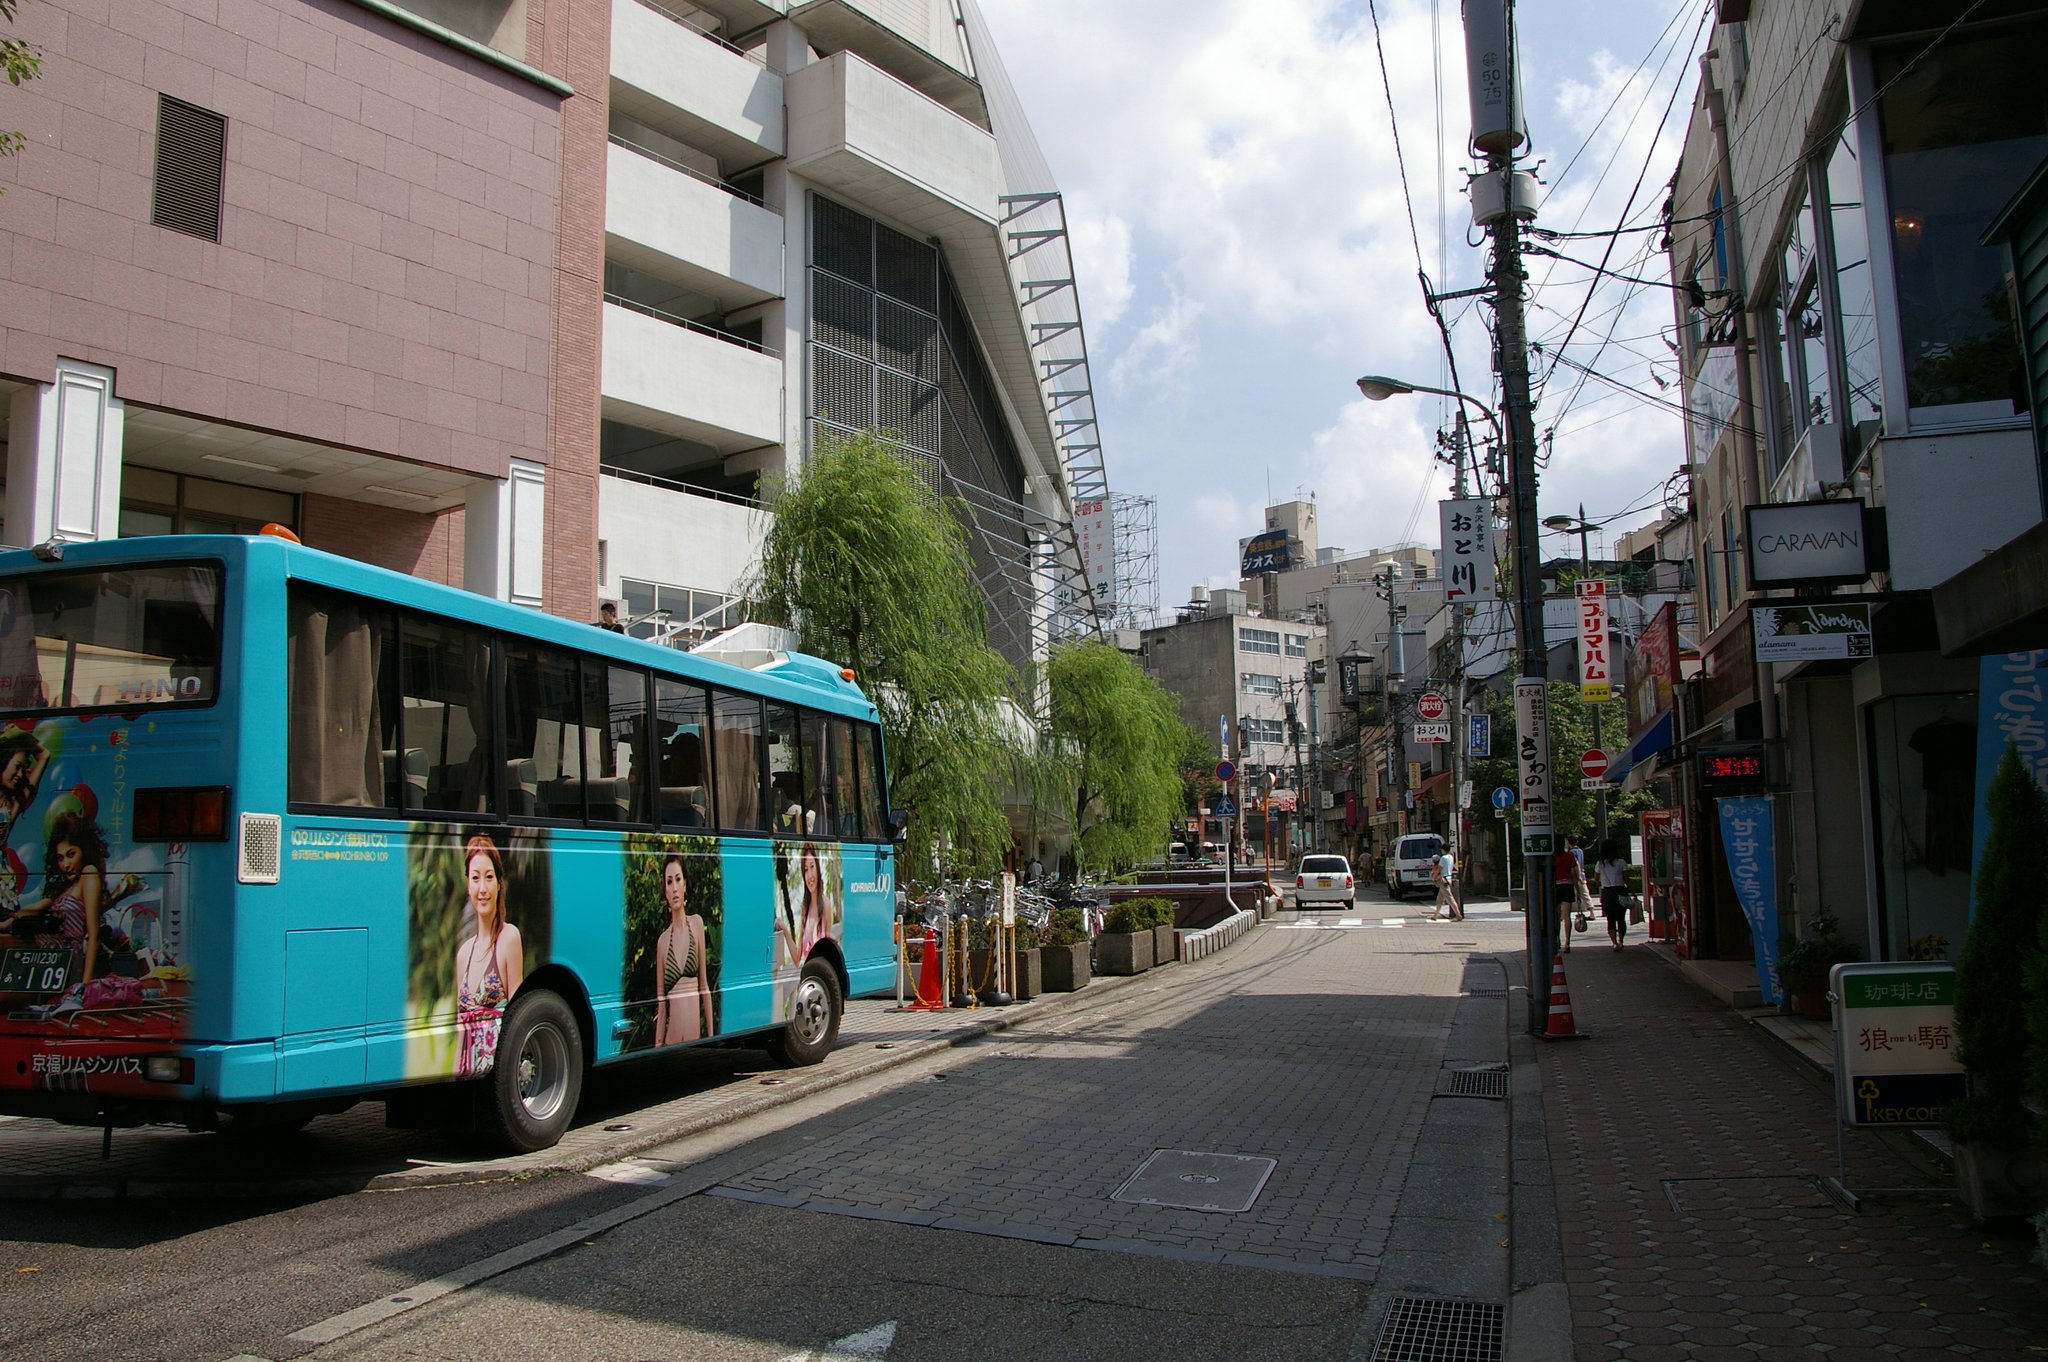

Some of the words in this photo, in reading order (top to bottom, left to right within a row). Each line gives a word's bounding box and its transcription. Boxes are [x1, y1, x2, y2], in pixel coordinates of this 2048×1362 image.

[1482, 69, 1501, 82] 50
[1484, 86, 1502, 99] 75
[1474, 504, 1485, 552] 金沢食事処
[1758, 530, 1858, 554] CARAVAN
[1243, 553, 1275, 571] ジオス
[1450, 512, 1477, 595] おと川
[1801, 606, 1869, 634] alamana
[1581, 603, 1606, 680] プリマハム
[1758, 639, 1796, 649] alamana
[120, 675, 201, 700] HINO
[1420, 701, 1443, 712] 消火栓
[1416, 725, 1448, 736] おと川
[1520, 735, 1547, 787] さわの
[4, 973, 13, 983] あ
[1864, 981, 1941, 1001] 珈琲店
[32, 1053, 143, 1075] 京福リムジンバス
[1872, 1107, 1904, 1121] KEY
